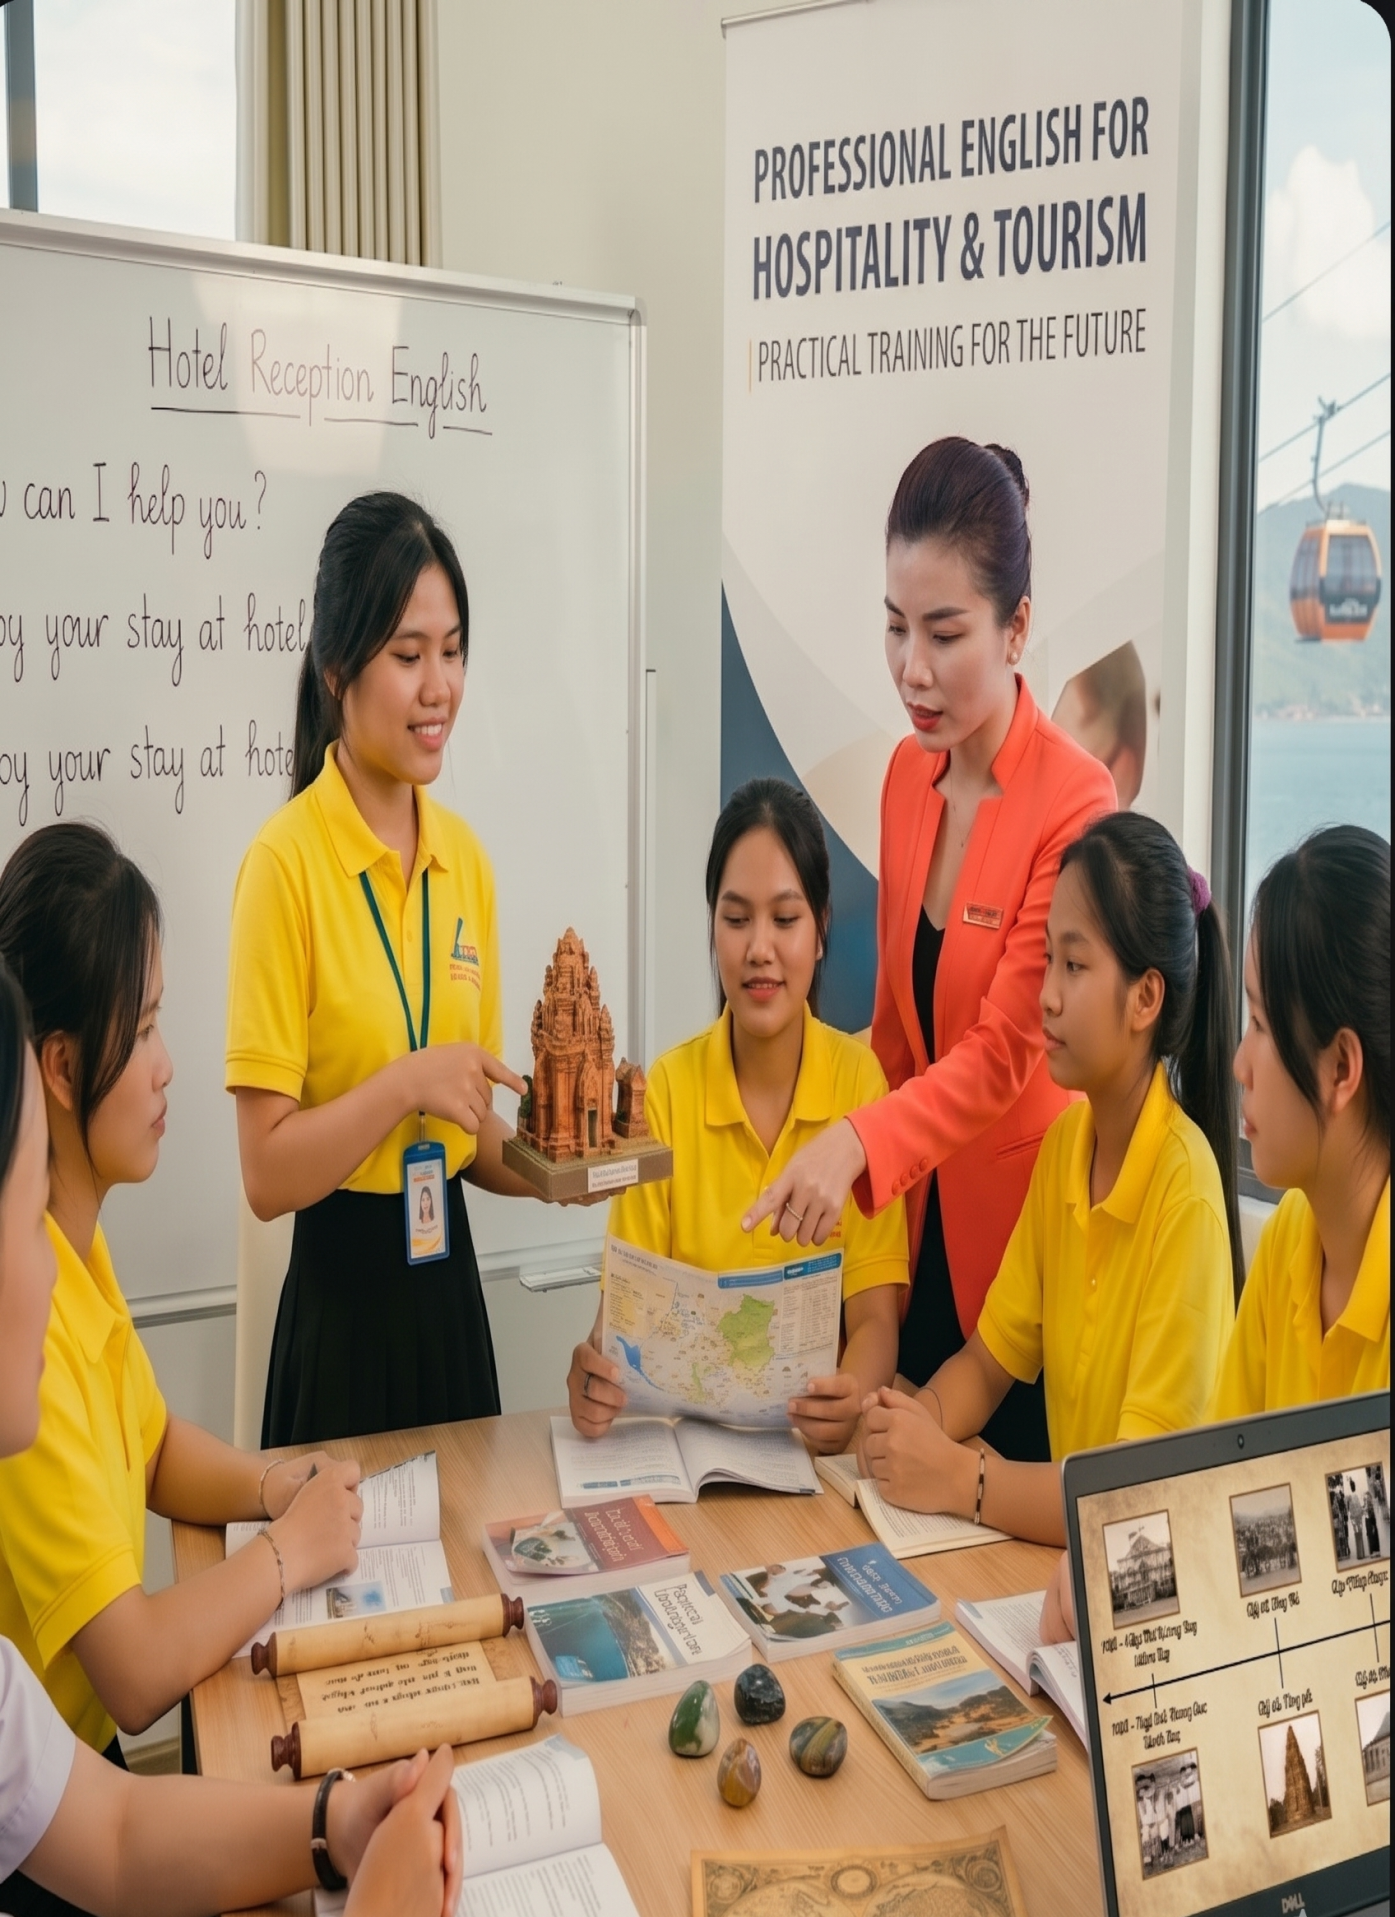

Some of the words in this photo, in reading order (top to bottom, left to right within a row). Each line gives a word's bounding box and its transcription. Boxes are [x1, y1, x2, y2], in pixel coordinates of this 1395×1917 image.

[754, 123, 951, 204] PROFESSIONAL
[961, 104, 1082, 178] ENGLISH
[1092, 96, 1150, 161] FOR
[753, 214, 952, 301] HOSPITALITY
[960, 211, 985, 281] &
[994, 192, 1147, 277] TOURISM
[148, 316, 228, 391] Hotel
[250, 328, 375, 427] Reception
[391, 345, 487, 439] English
[758, 333, 862, 382] PRACTICAL
[867, 325, 963, 374] TRAINING
[971, 320, 1010, 367] FOR
[1016, 316, 1057, 363] THE
[1063, 308, 1147, 359] FUTURE
[23, 482, 76, 520] can
[92, 461, 110, 523] I
[126, 461, 186, 556] help
[199, 470, 267, 560] you?
[45, 613, 110, 681] your
[126, 592, 185, 687] stay
[198, 594, 226, 652] at
[244, 592, 306, 652] hotel
[48, 747, 112, 818] your
[130, 724, 185, 815] stay
[199, 724, 227, 778] at
[245, 719, 295, 777] hote
